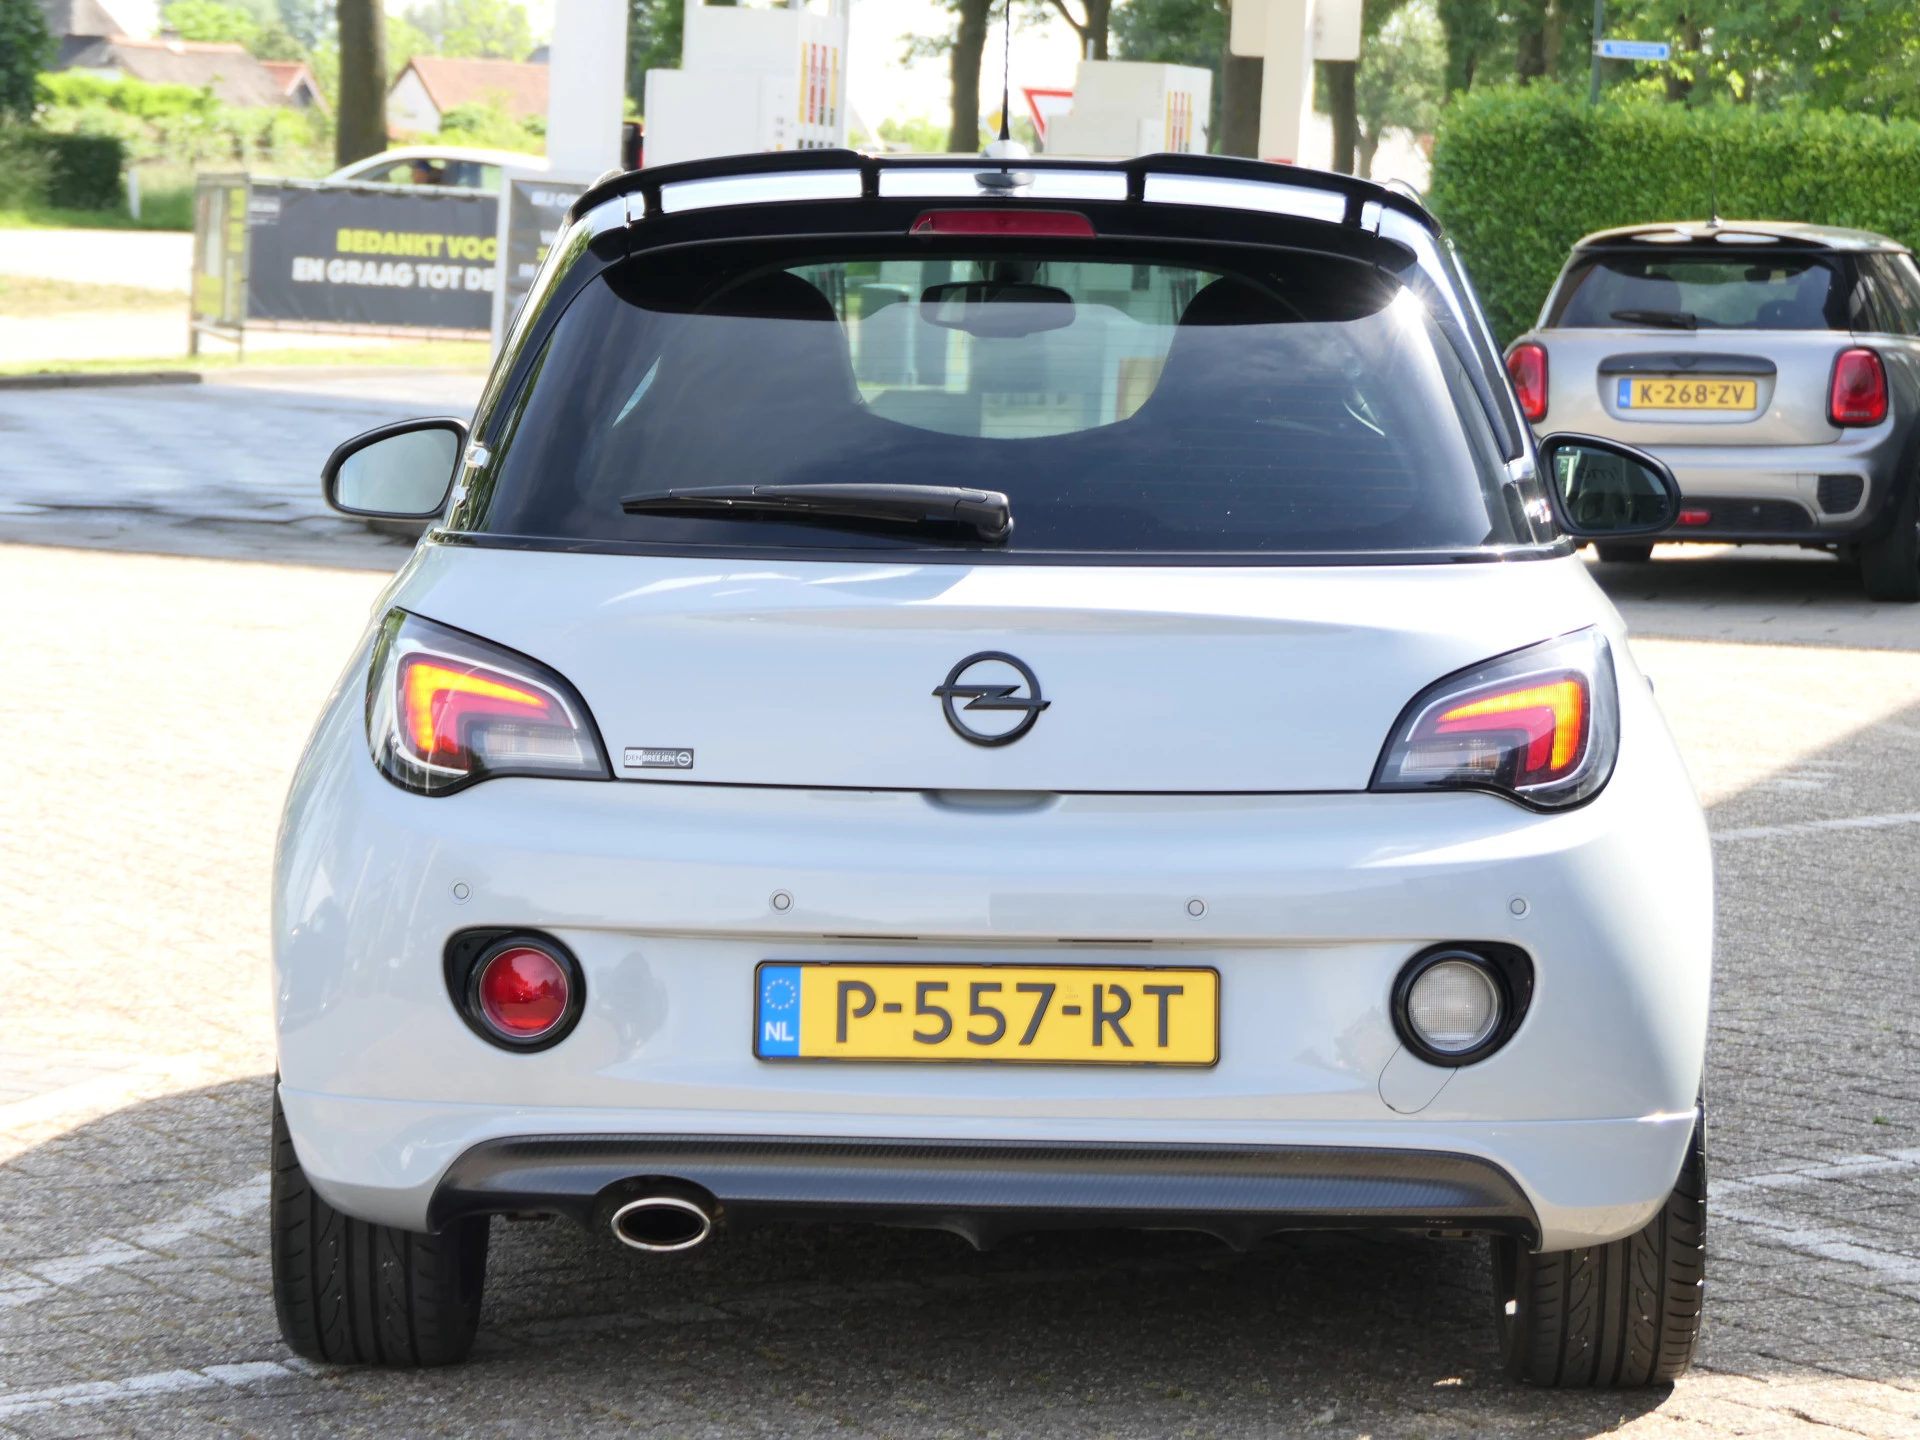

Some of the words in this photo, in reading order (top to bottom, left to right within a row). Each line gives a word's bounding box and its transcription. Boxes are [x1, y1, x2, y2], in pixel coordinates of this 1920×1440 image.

[336, 228, 445, 258] BEDANKT
[292, 257, 326, 283] EN
[326, 258, 415, 288] GRAAG
[415, 263, 464, 290] TOT
[1639, 383, 1746, 405] K-268-ZV
[763, 1020, 794, 1043] NL
[834, 979, 1185, 1049] P-557-RT
